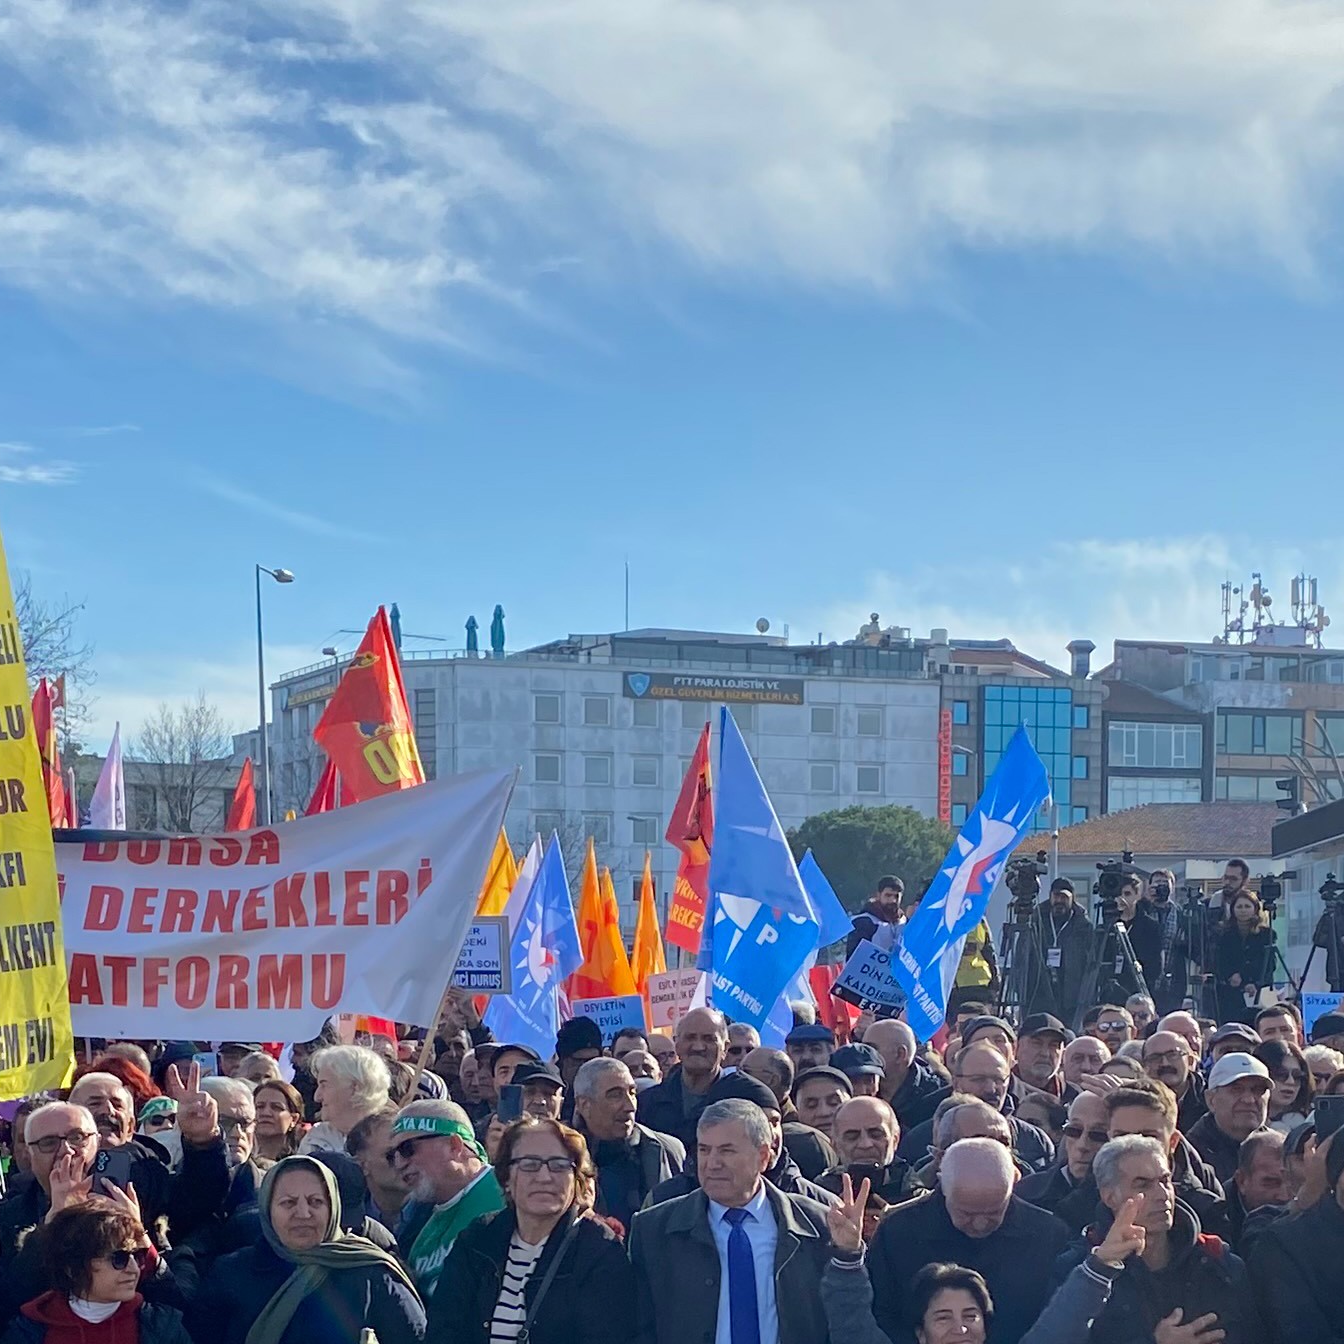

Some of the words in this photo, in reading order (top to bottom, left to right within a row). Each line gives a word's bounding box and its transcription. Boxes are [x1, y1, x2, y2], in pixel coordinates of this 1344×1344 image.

[673, 676, 694, 686] PTT
[694, 677, 722, 688] PARA
[722, 677, 765, 690] LOJİSTİK
[767, 680, 780, 691] VE
[679, 687, 726, 699] GÜVENLİK
[726, 688, 783, 702] HİZMETLERİ
[83, 857, 435, 935] DERNEKLERİ
[26, 1002, 55, 1065] EVİ
